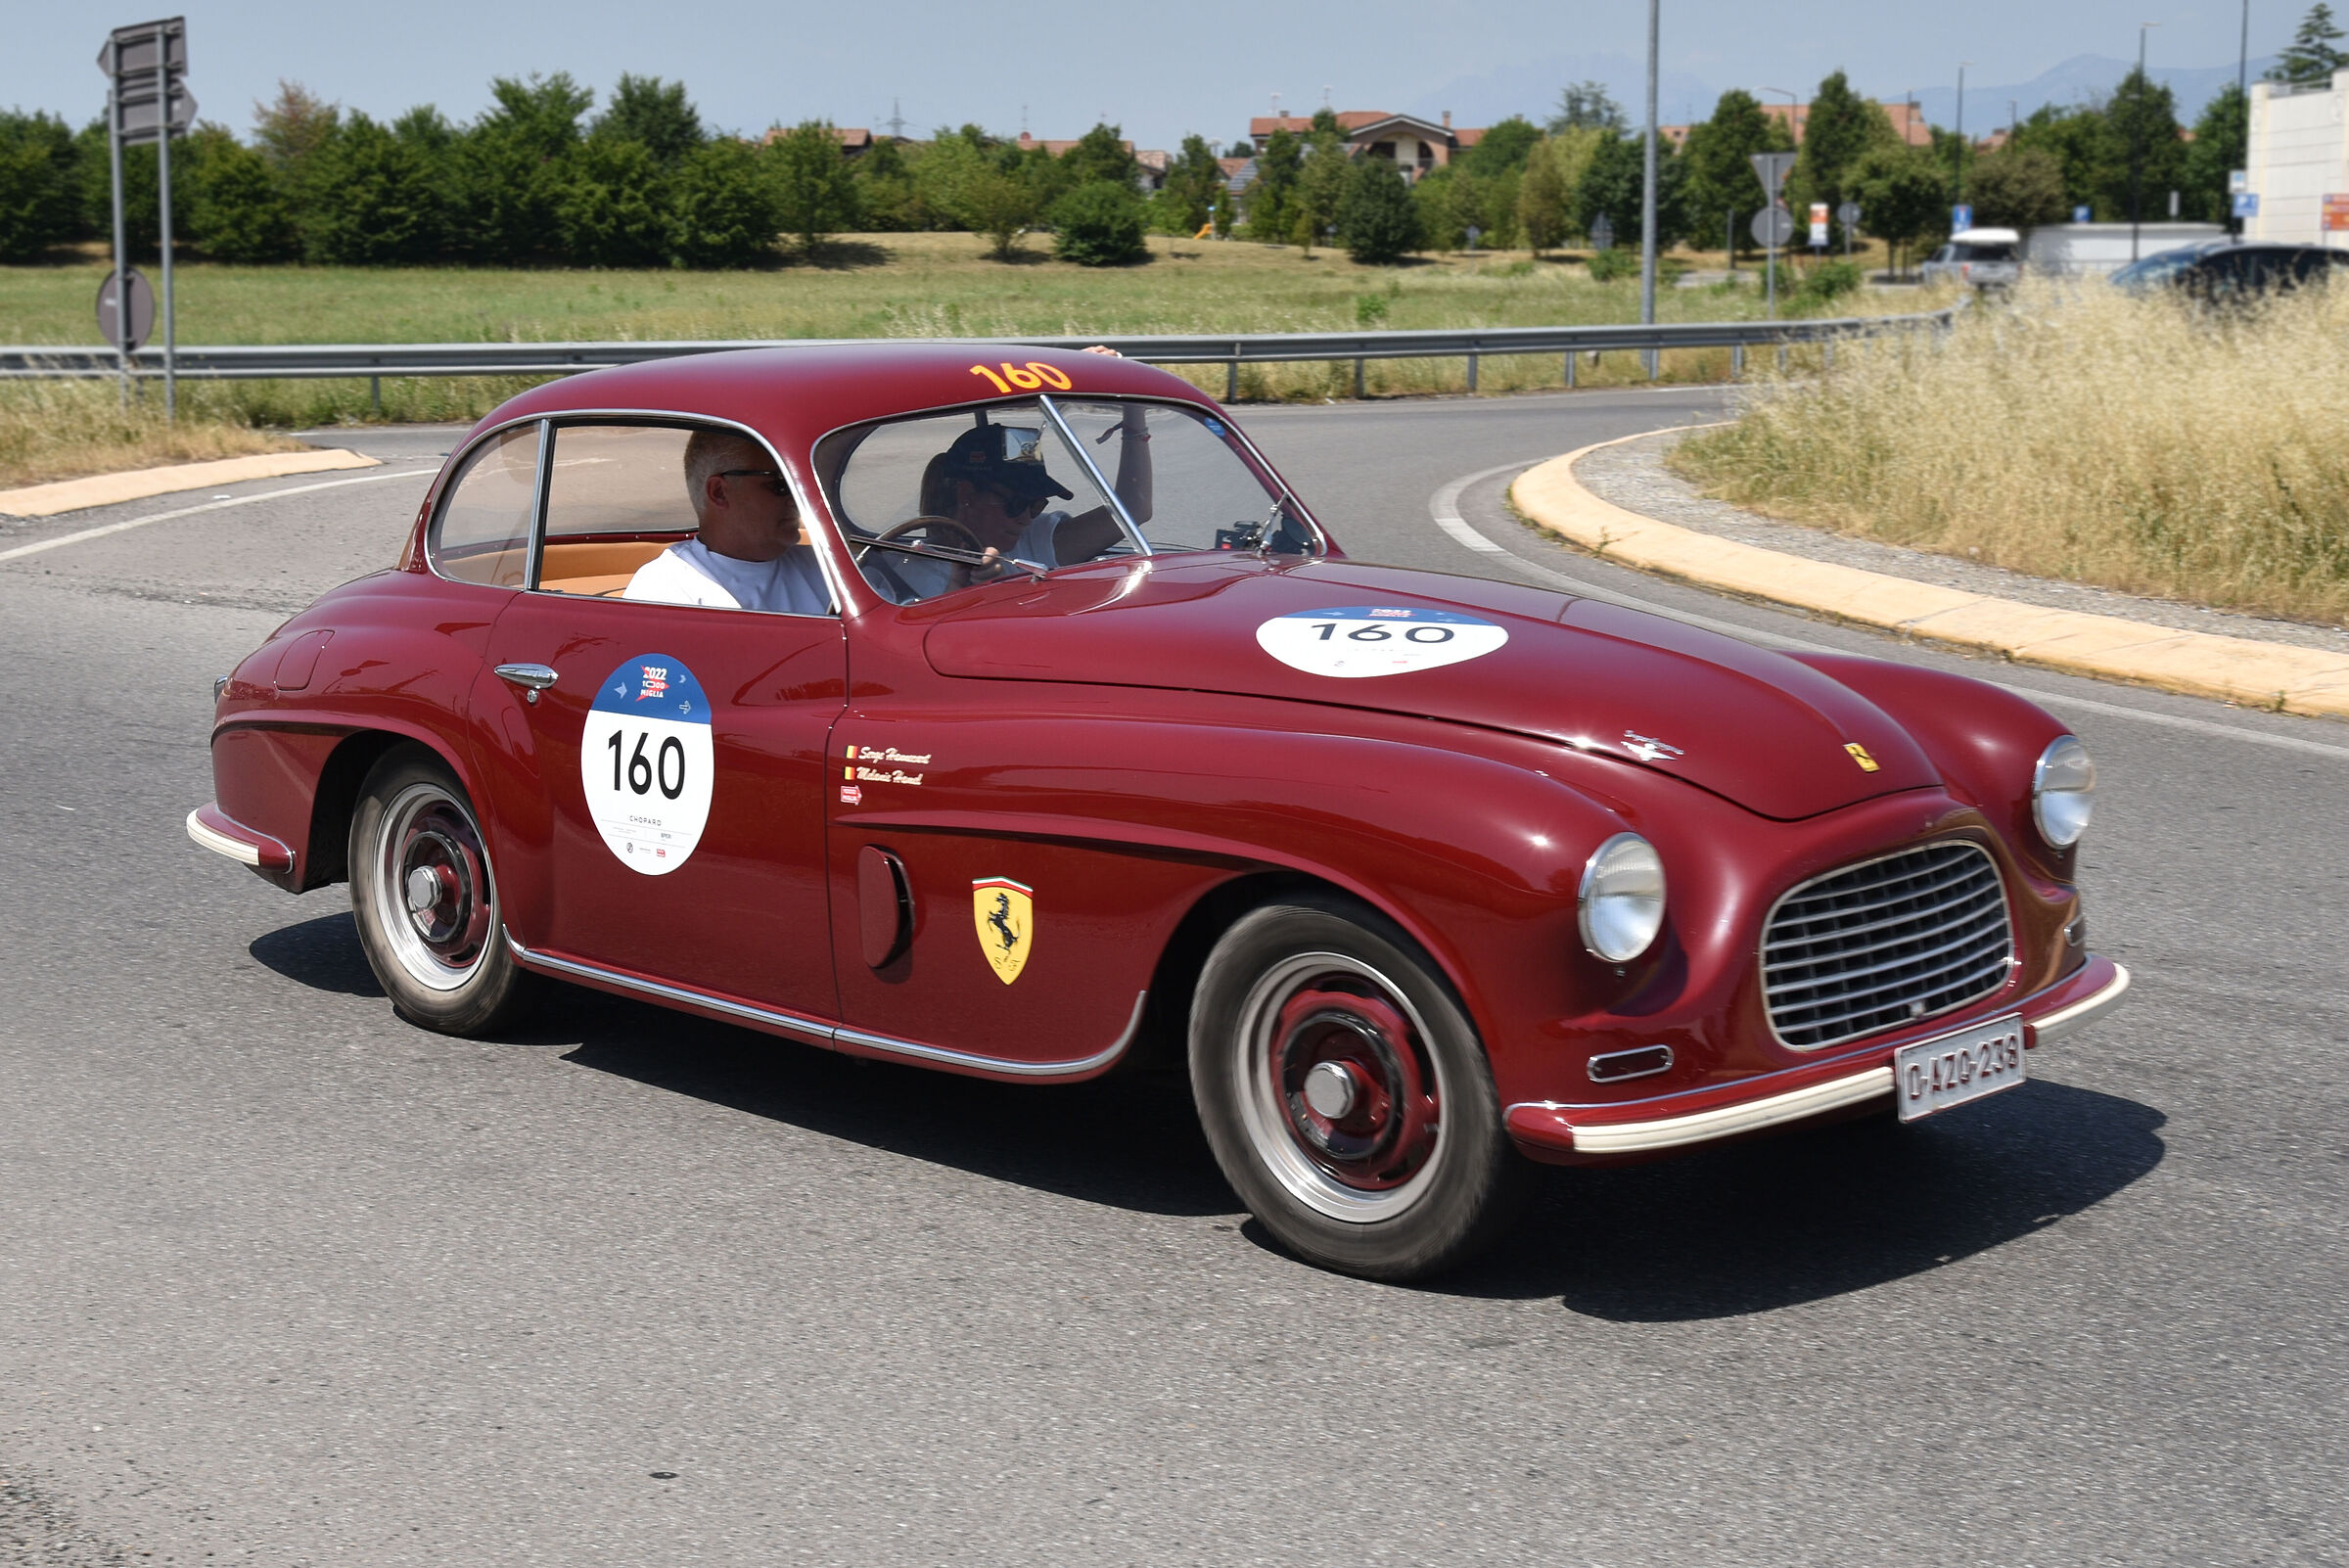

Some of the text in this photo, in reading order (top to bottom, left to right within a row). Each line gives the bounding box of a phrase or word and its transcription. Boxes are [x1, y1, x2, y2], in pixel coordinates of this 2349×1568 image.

[969, 361, 1073, 393] 160
[1311, 623, 1455, 644] 160
[643, 666, 668, 680] 2022
[642, 680, 666, 690] 1000
[640, 688, 664, 698] MIGLIA
[608, 729, 685, 800] 160
[628, 815, 662, 826] CHOPARD
